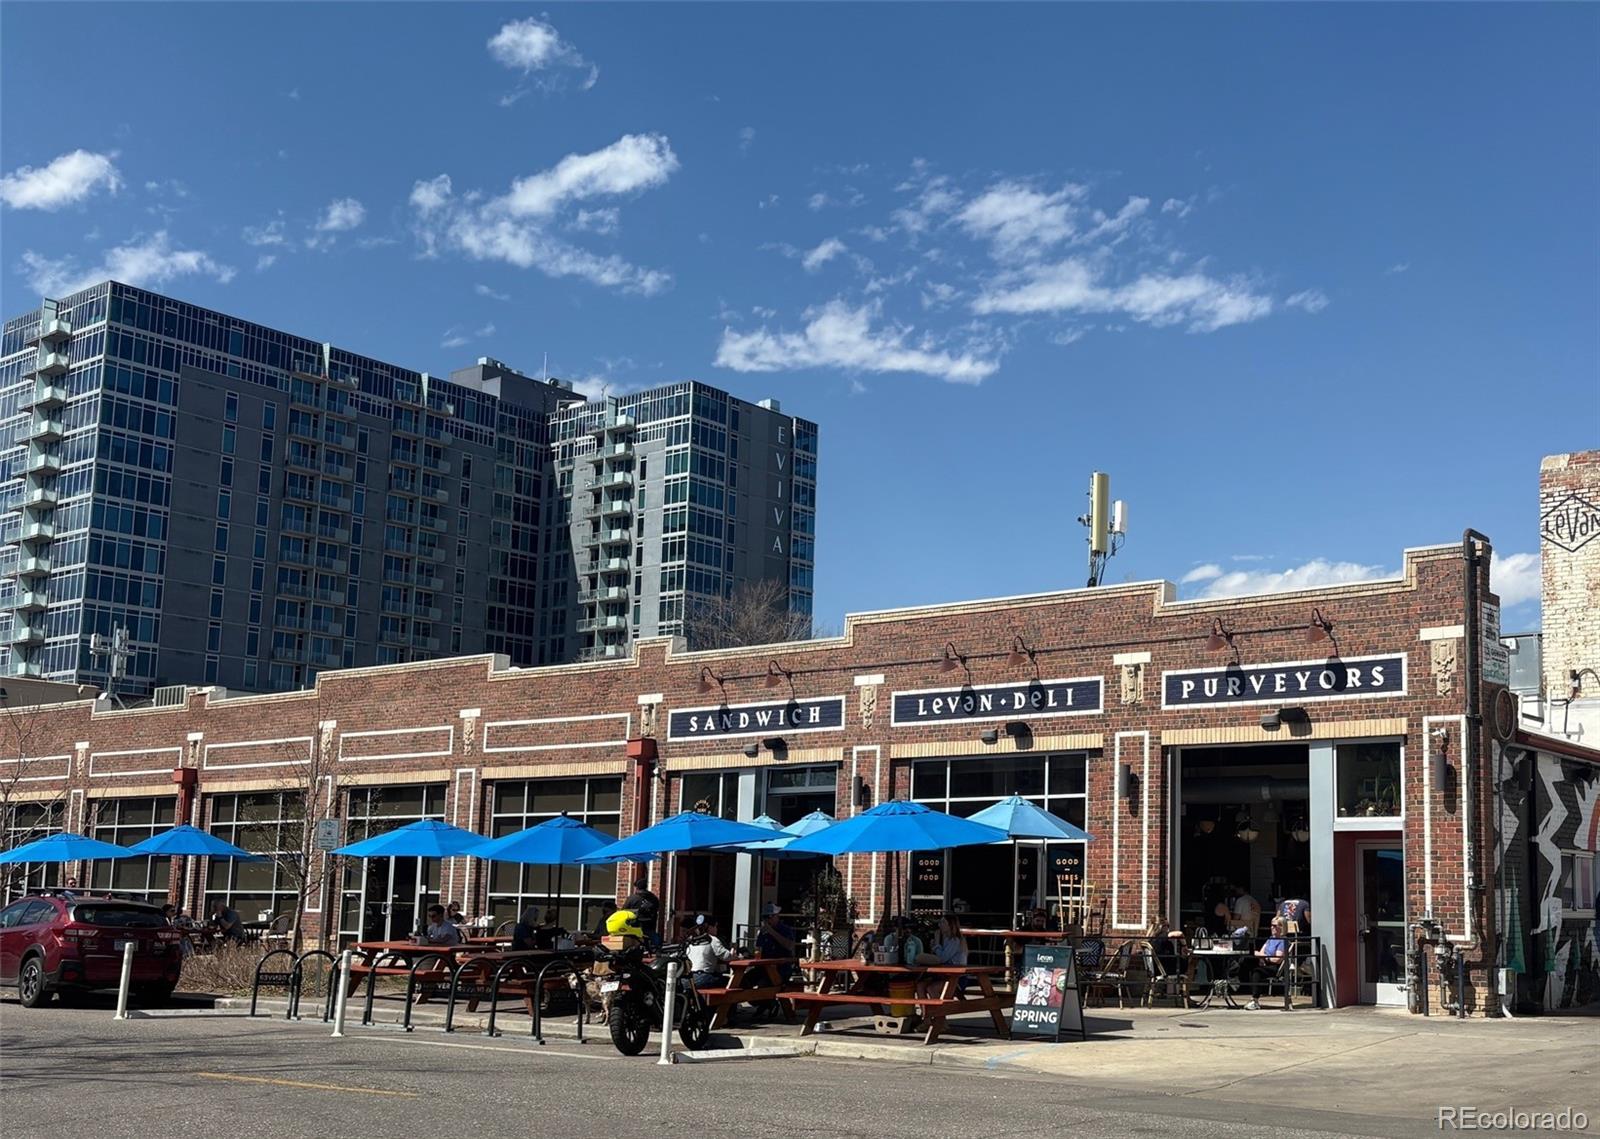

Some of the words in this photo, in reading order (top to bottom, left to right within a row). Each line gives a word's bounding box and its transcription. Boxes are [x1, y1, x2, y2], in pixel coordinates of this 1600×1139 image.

[772, 425, 786, 554] EVIVA
[1181, 666, 1385, 699] PURVEYORS
[689, 706, 821, 732] SANDWICH
[1055, 858, 1079, 866] GOOD
[1014, 1009, 1058, 1023] SPRING
